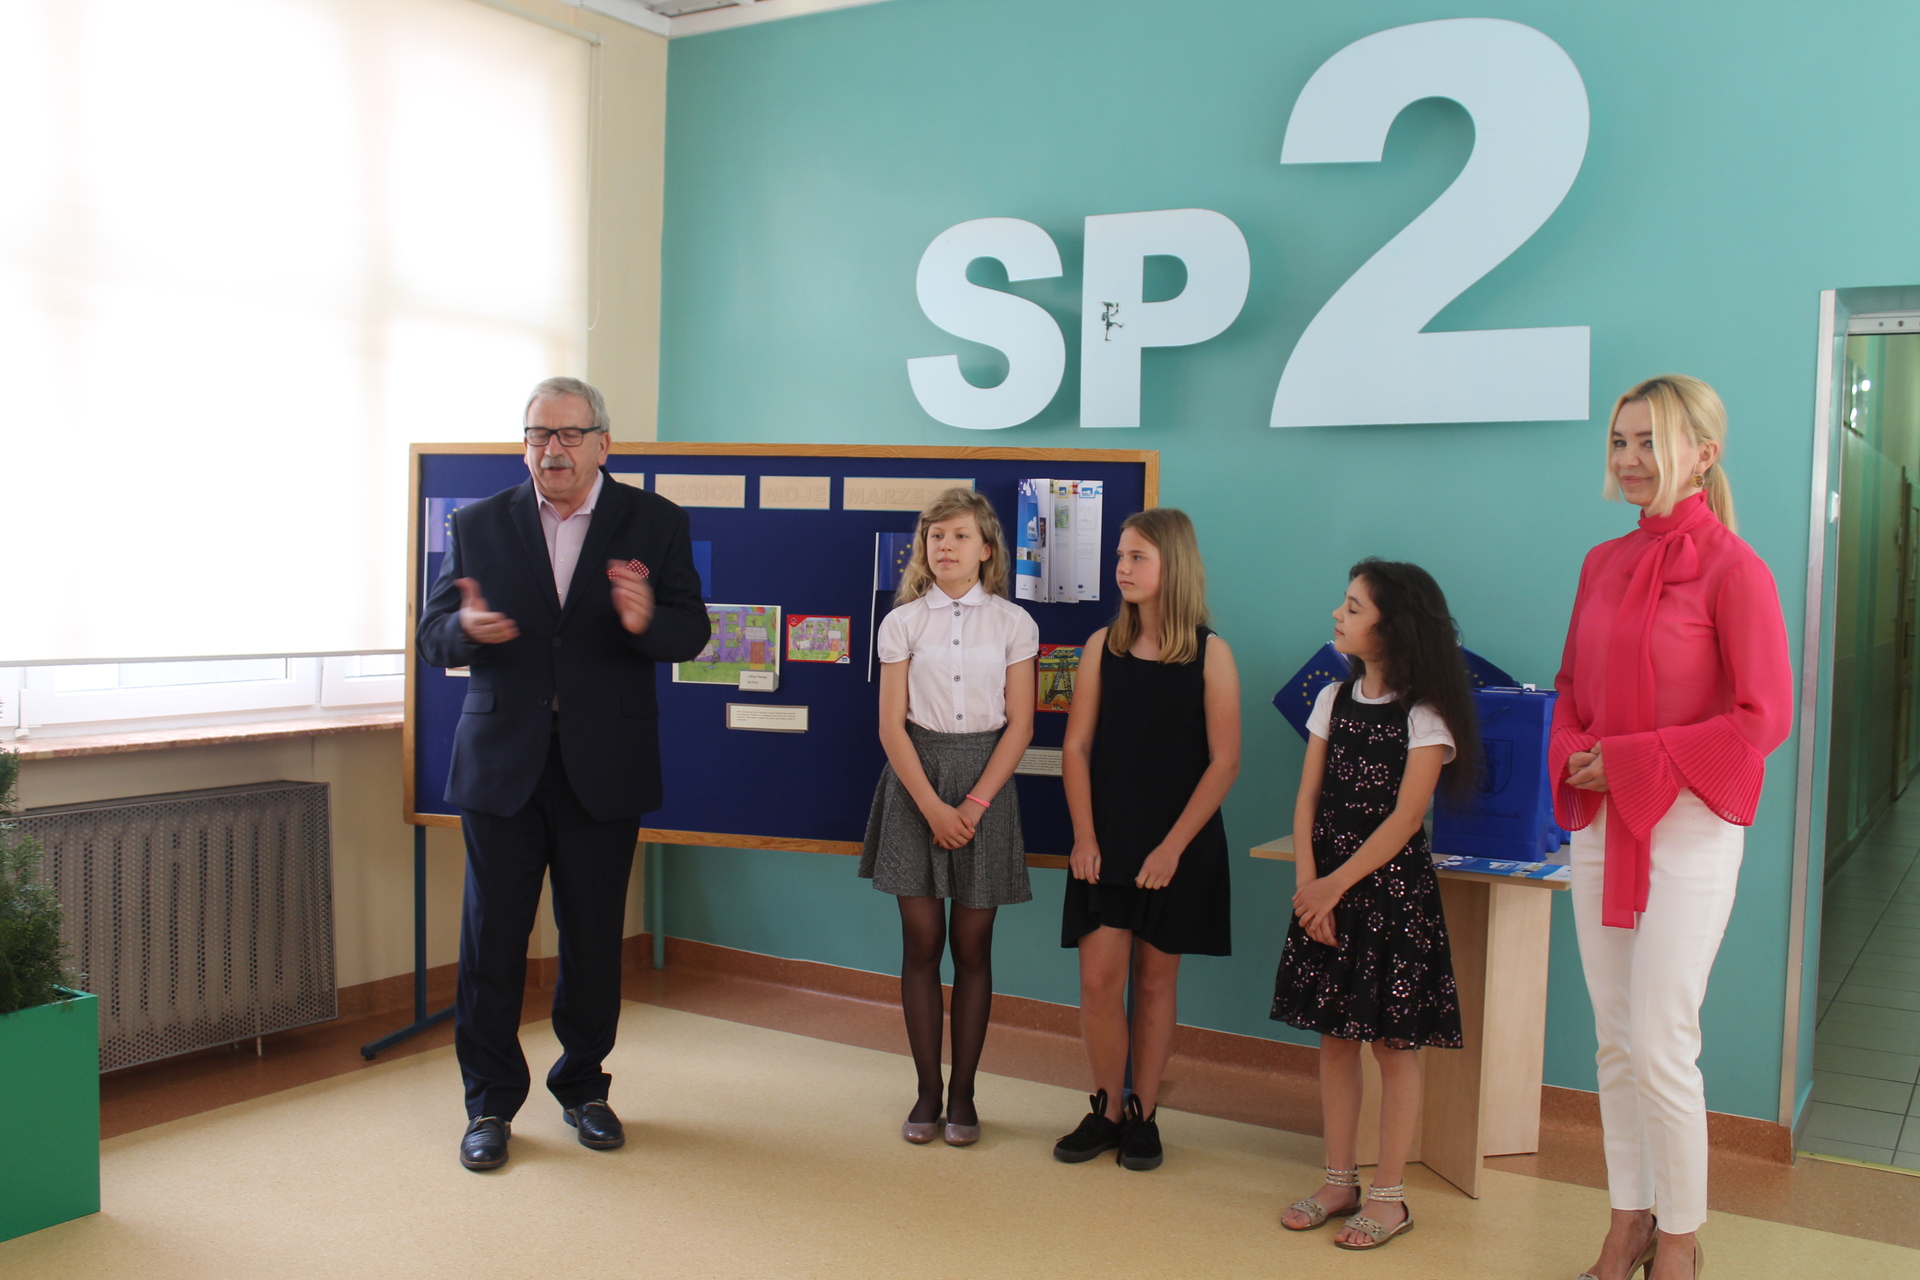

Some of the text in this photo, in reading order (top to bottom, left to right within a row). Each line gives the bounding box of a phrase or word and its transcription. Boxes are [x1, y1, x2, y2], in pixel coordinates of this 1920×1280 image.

[1270, 17, 1591, 428] 2
[657, 483, 742, 501] REGION
[764, 485, 827, 503] MOJE
